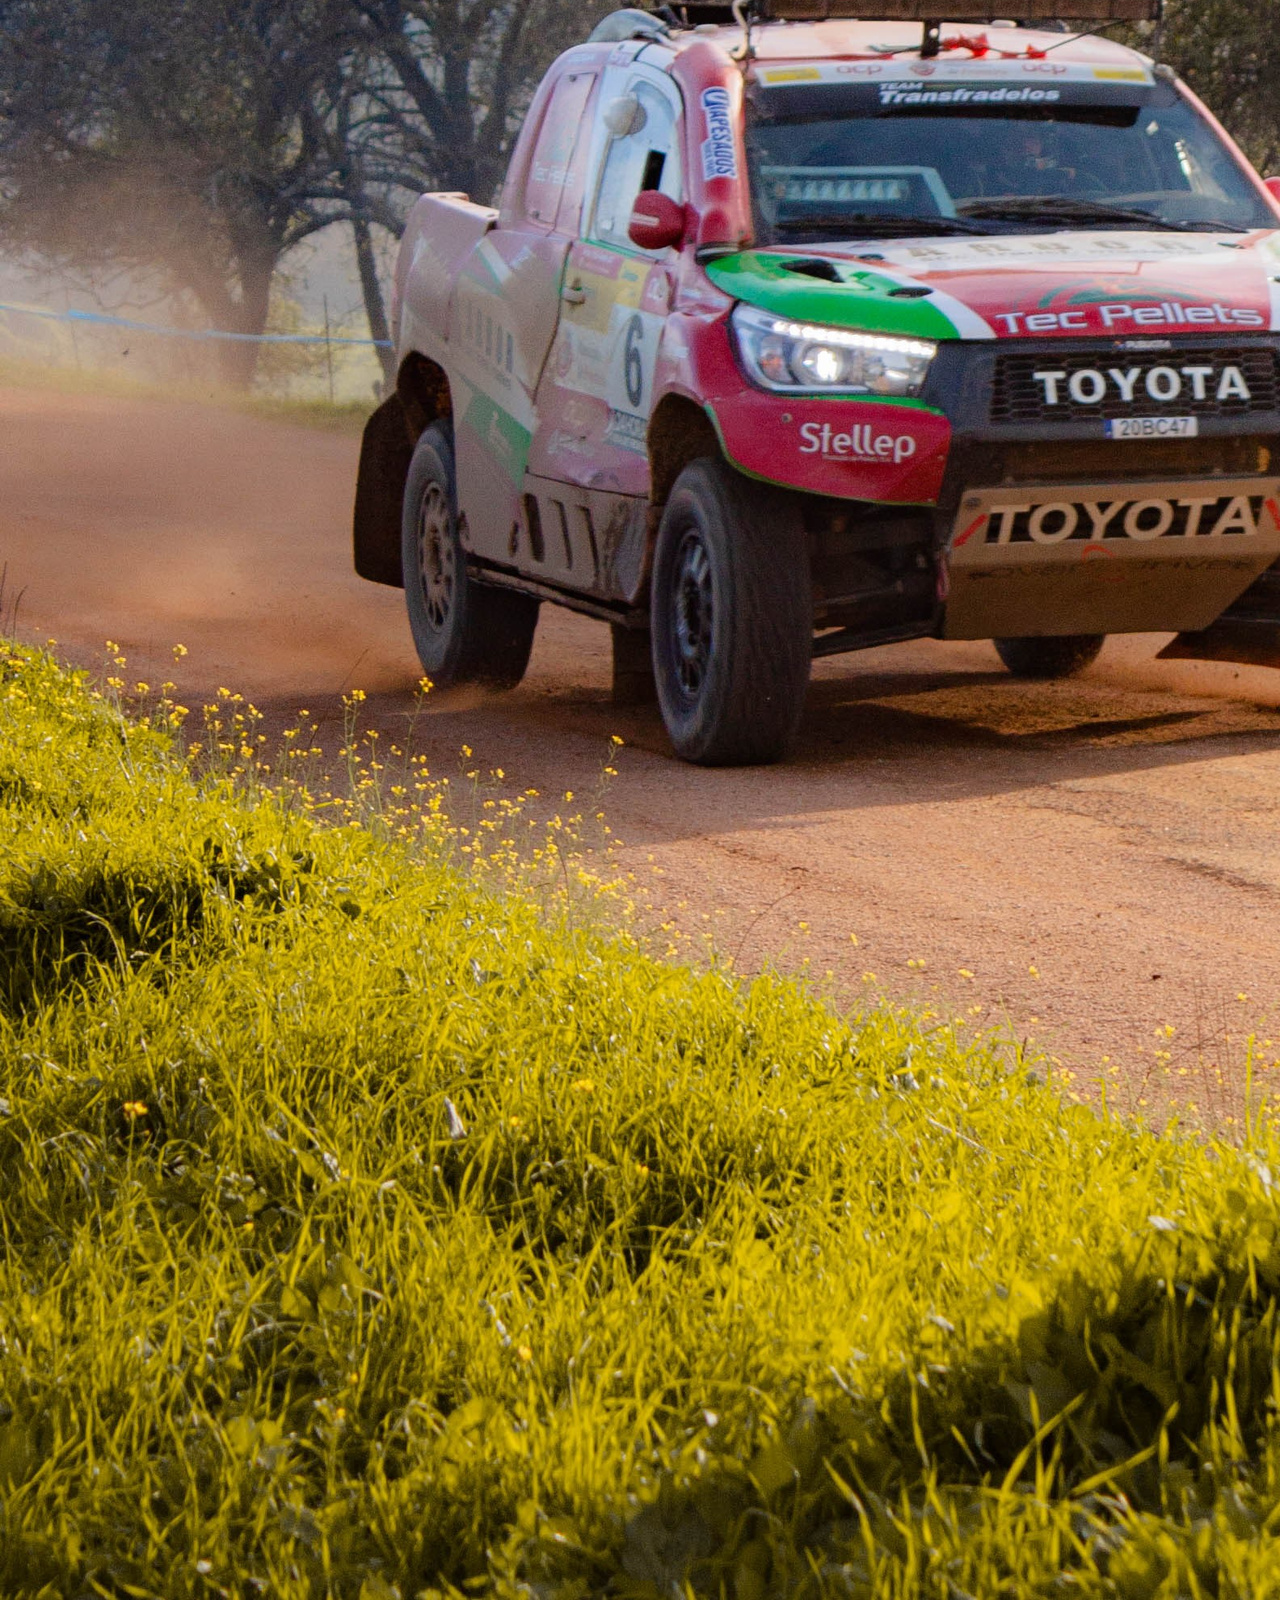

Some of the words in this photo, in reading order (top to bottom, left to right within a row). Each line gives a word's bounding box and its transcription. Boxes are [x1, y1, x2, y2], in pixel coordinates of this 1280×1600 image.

[836, 64, 882, 76] acp
[880, 82, 923, 91] TEAM
[880, 87, 1060, 105] Transfradelos
[995, 310, 1088, 334] Tec
[1099, 303, 1265, 328] Pellets
[623, 313, 644, 408] 6
[1032, 365, 1251, 405] TOYOTA
[799, 422, 917, 463] Stellep
[1120, 418, 1190, 437] 20BC47
[988, 495, 1258, 545] TOYOTA
